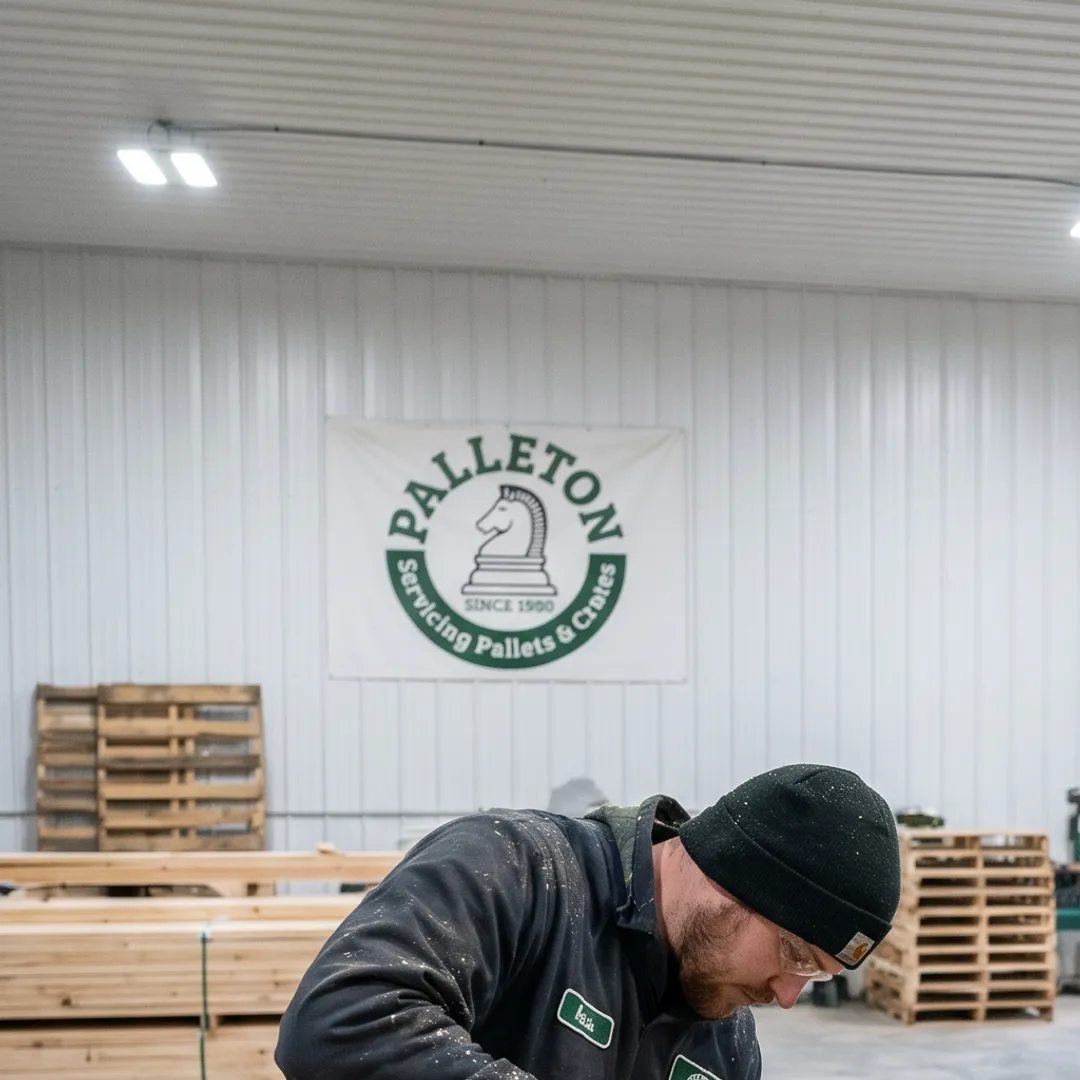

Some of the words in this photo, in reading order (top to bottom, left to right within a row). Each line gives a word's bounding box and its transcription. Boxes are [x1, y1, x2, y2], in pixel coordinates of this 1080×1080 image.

[388, 433, 623, 545] PALLETON
[396, 557, 473, 654] Servicing
[474, 633, 557, 659] Pallets
[555, 624, 577, 644] &
[465, 599, 513, 612] SINCE
